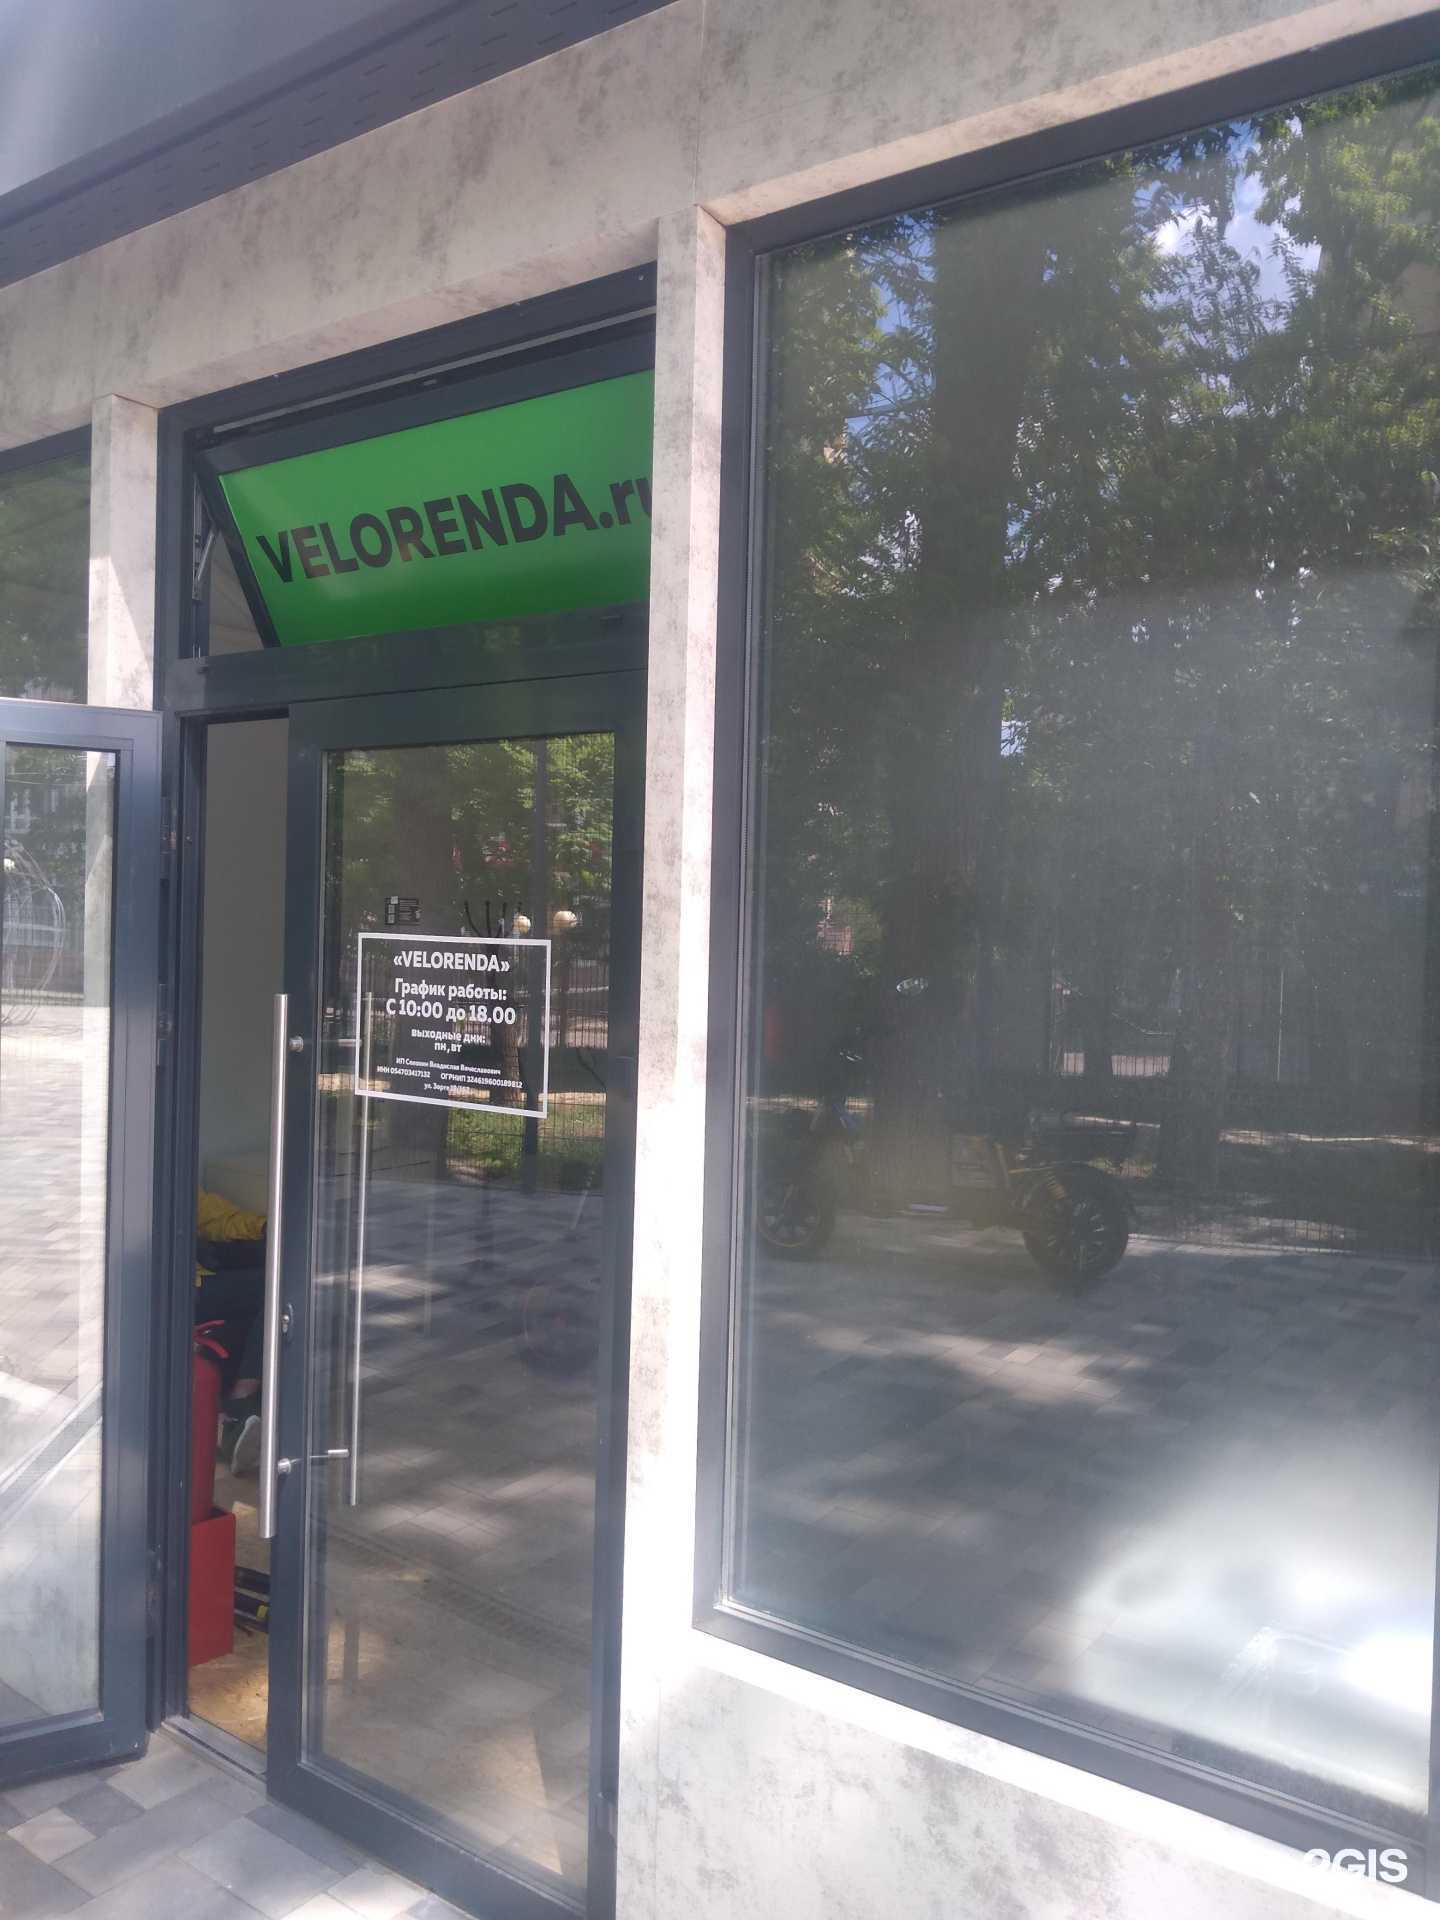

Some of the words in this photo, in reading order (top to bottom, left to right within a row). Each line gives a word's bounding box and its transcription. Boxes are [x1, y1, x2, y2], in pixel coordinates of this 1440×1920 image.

[393, 951, 510, 972] «VELORENDA»
[395, 978, 445, 999] График
[448, 984, 507, 1001] работы:
[386, 999, 396, 1015] С
[399, 999, 443, 1018] 10:00
[446, 1007, 465, 1022] до
[469, 1005, 516, 1025] 18.00
[411, 1028, 462, 1043] выходные
[463, 1032, 486, 1044] дни:
[377, 1065, 390, 1073] ИНН
[440, 1073, 466, 1082] ОГРНИП
